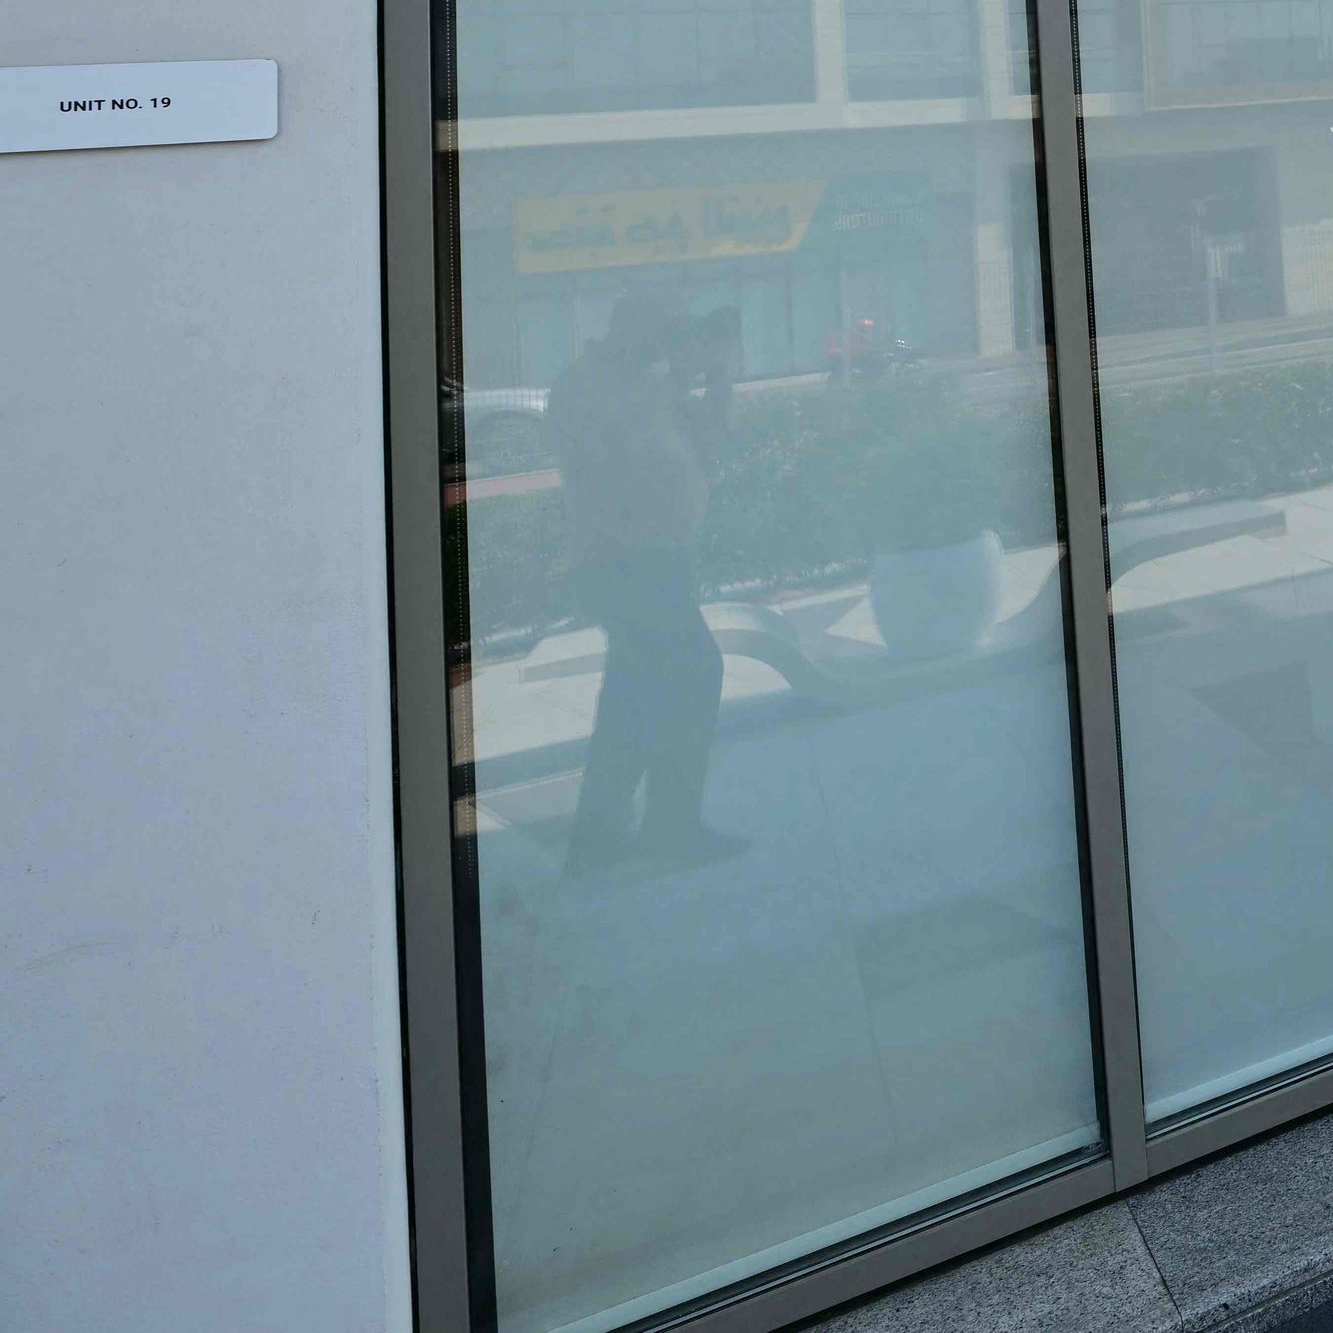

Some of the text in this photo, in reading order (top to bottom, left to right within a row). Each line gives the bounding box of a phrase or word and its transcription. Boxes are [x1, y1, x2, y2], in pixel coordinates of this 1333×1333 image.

[60, 97, 171, 112] UNIT NO. 19
